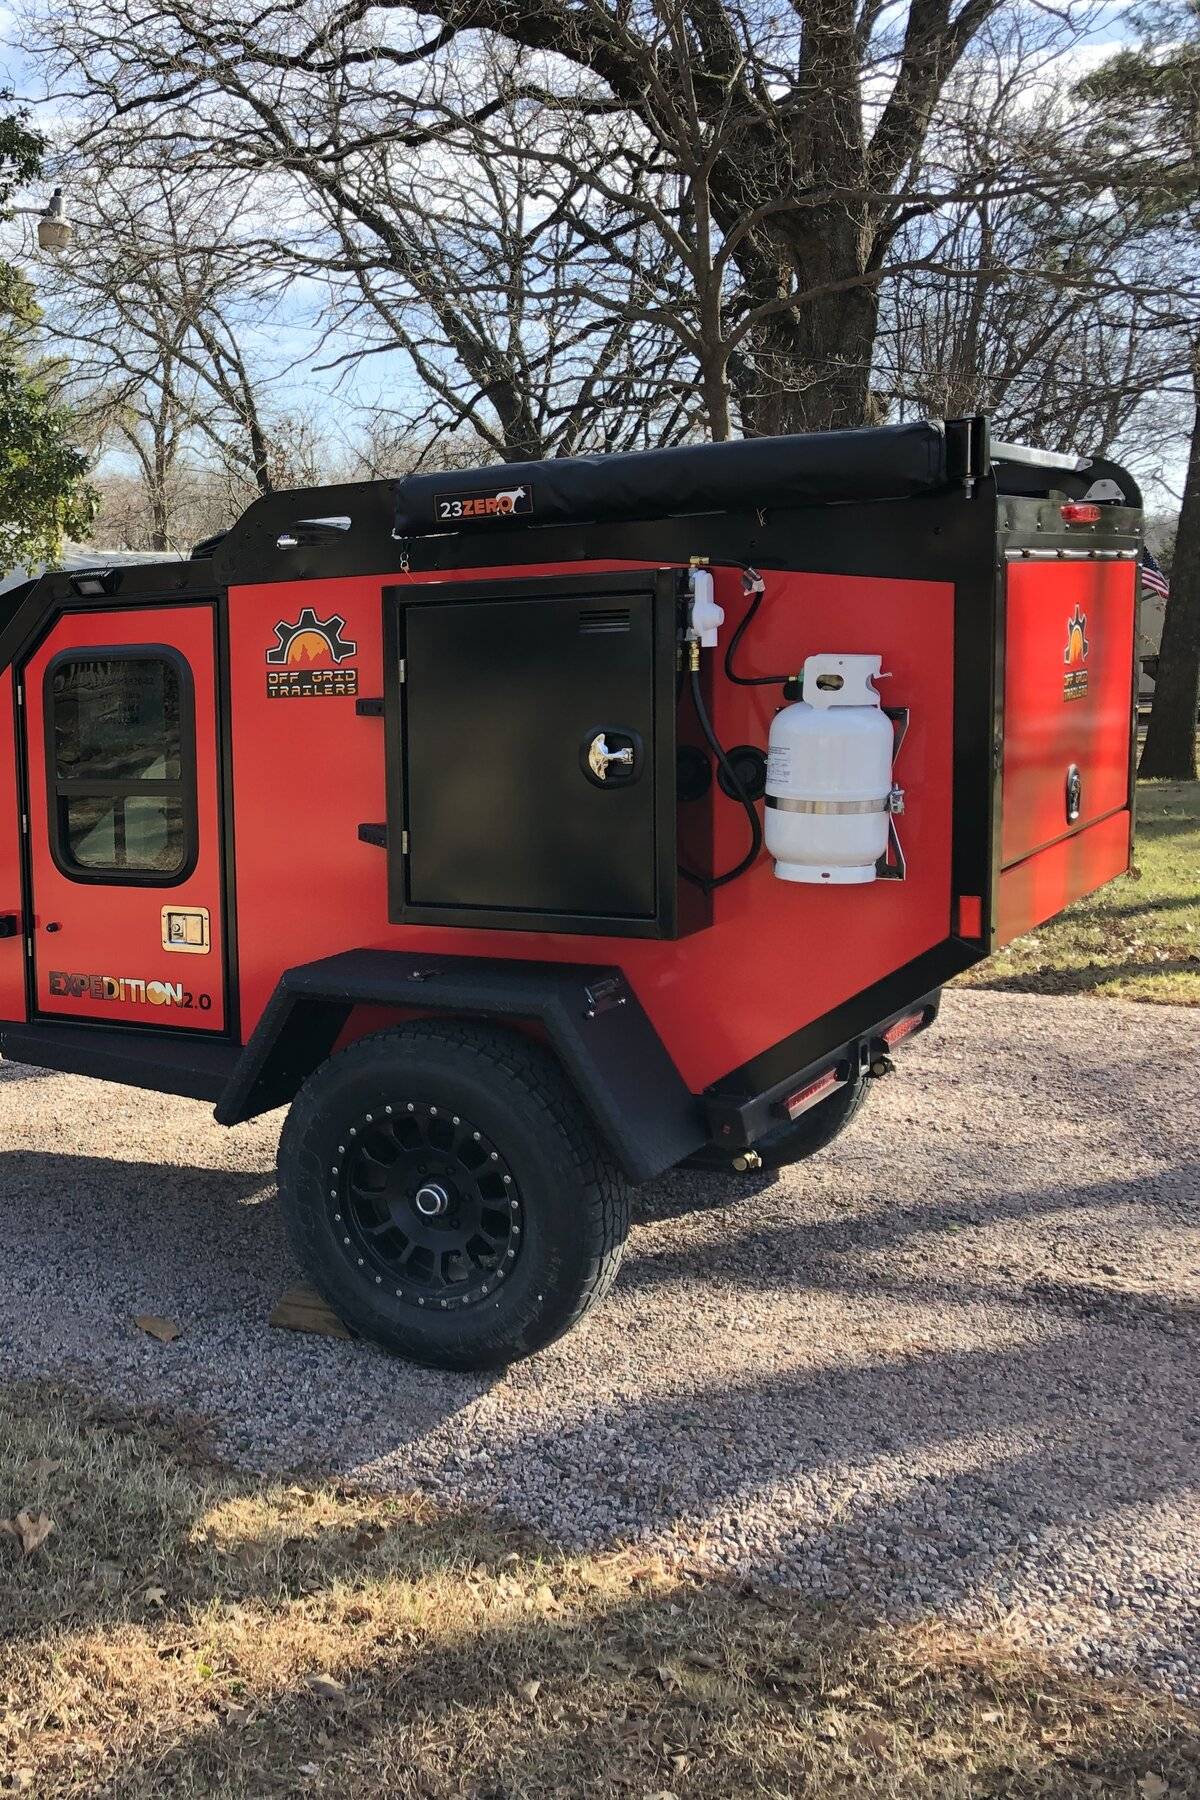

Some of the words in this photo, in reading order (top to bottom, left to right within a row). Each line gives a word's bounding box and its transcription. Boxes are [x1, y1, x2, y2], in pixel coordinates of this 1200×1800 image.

[440, 496, 513, 518] 23ZERO
[268, 672, 300, 684] OFF
[311, 670, 356, 682] GRID
[268, 684, 356, 696] TRAILERS
[49, 971, 184, 1008] EXPEDITION
[183, 993, 212, 1010] 2.0
